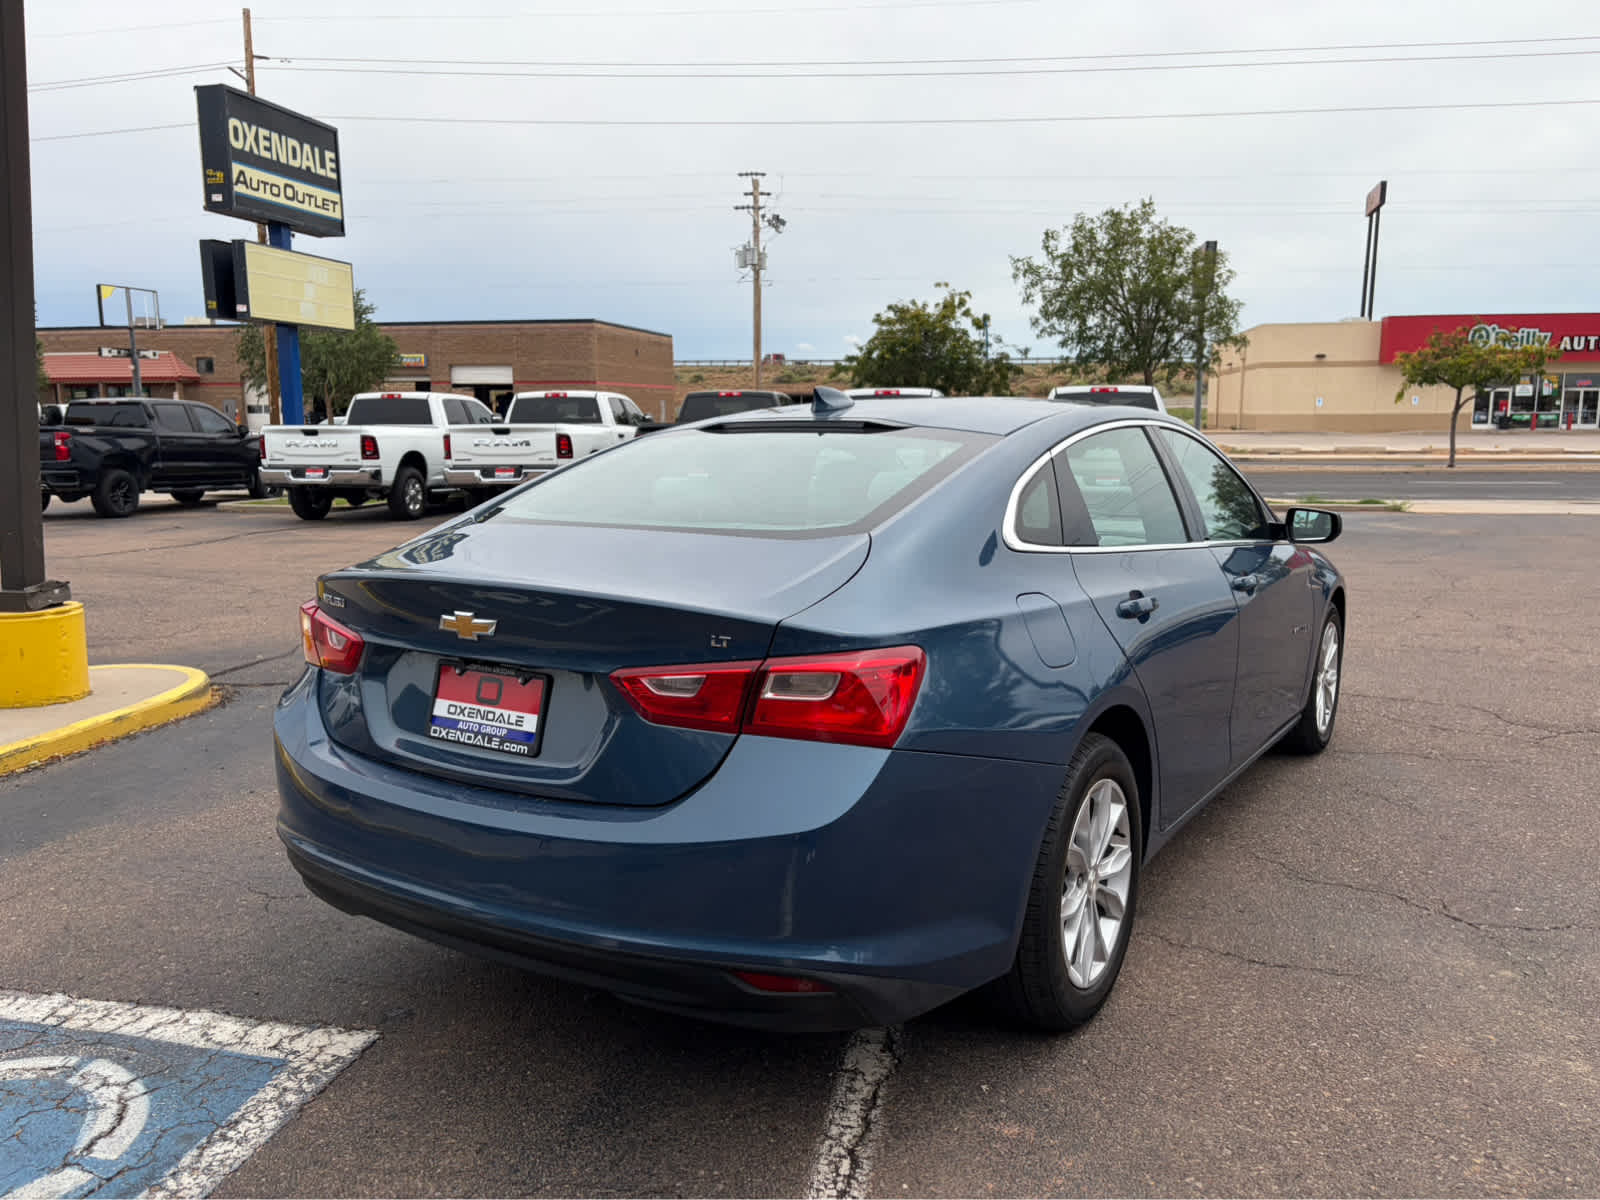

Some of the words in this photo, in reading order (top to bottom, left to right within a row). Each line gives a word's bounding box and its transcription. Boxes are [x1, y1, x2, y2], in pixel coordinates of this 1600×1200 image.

[228, 117, 338, 180] OXENDALE
[1560, 335, 1600, 351] AUT
[285, 439, 338, 448] RAM
[711, 634, 732, 648] LT
[447, 703, 525, 728] OXENDALE
[457, 720, 480, 733] AUTO
[480, 724, 508, 737] GROUP
[430, 726, 529, 754] OXENDALE.com
